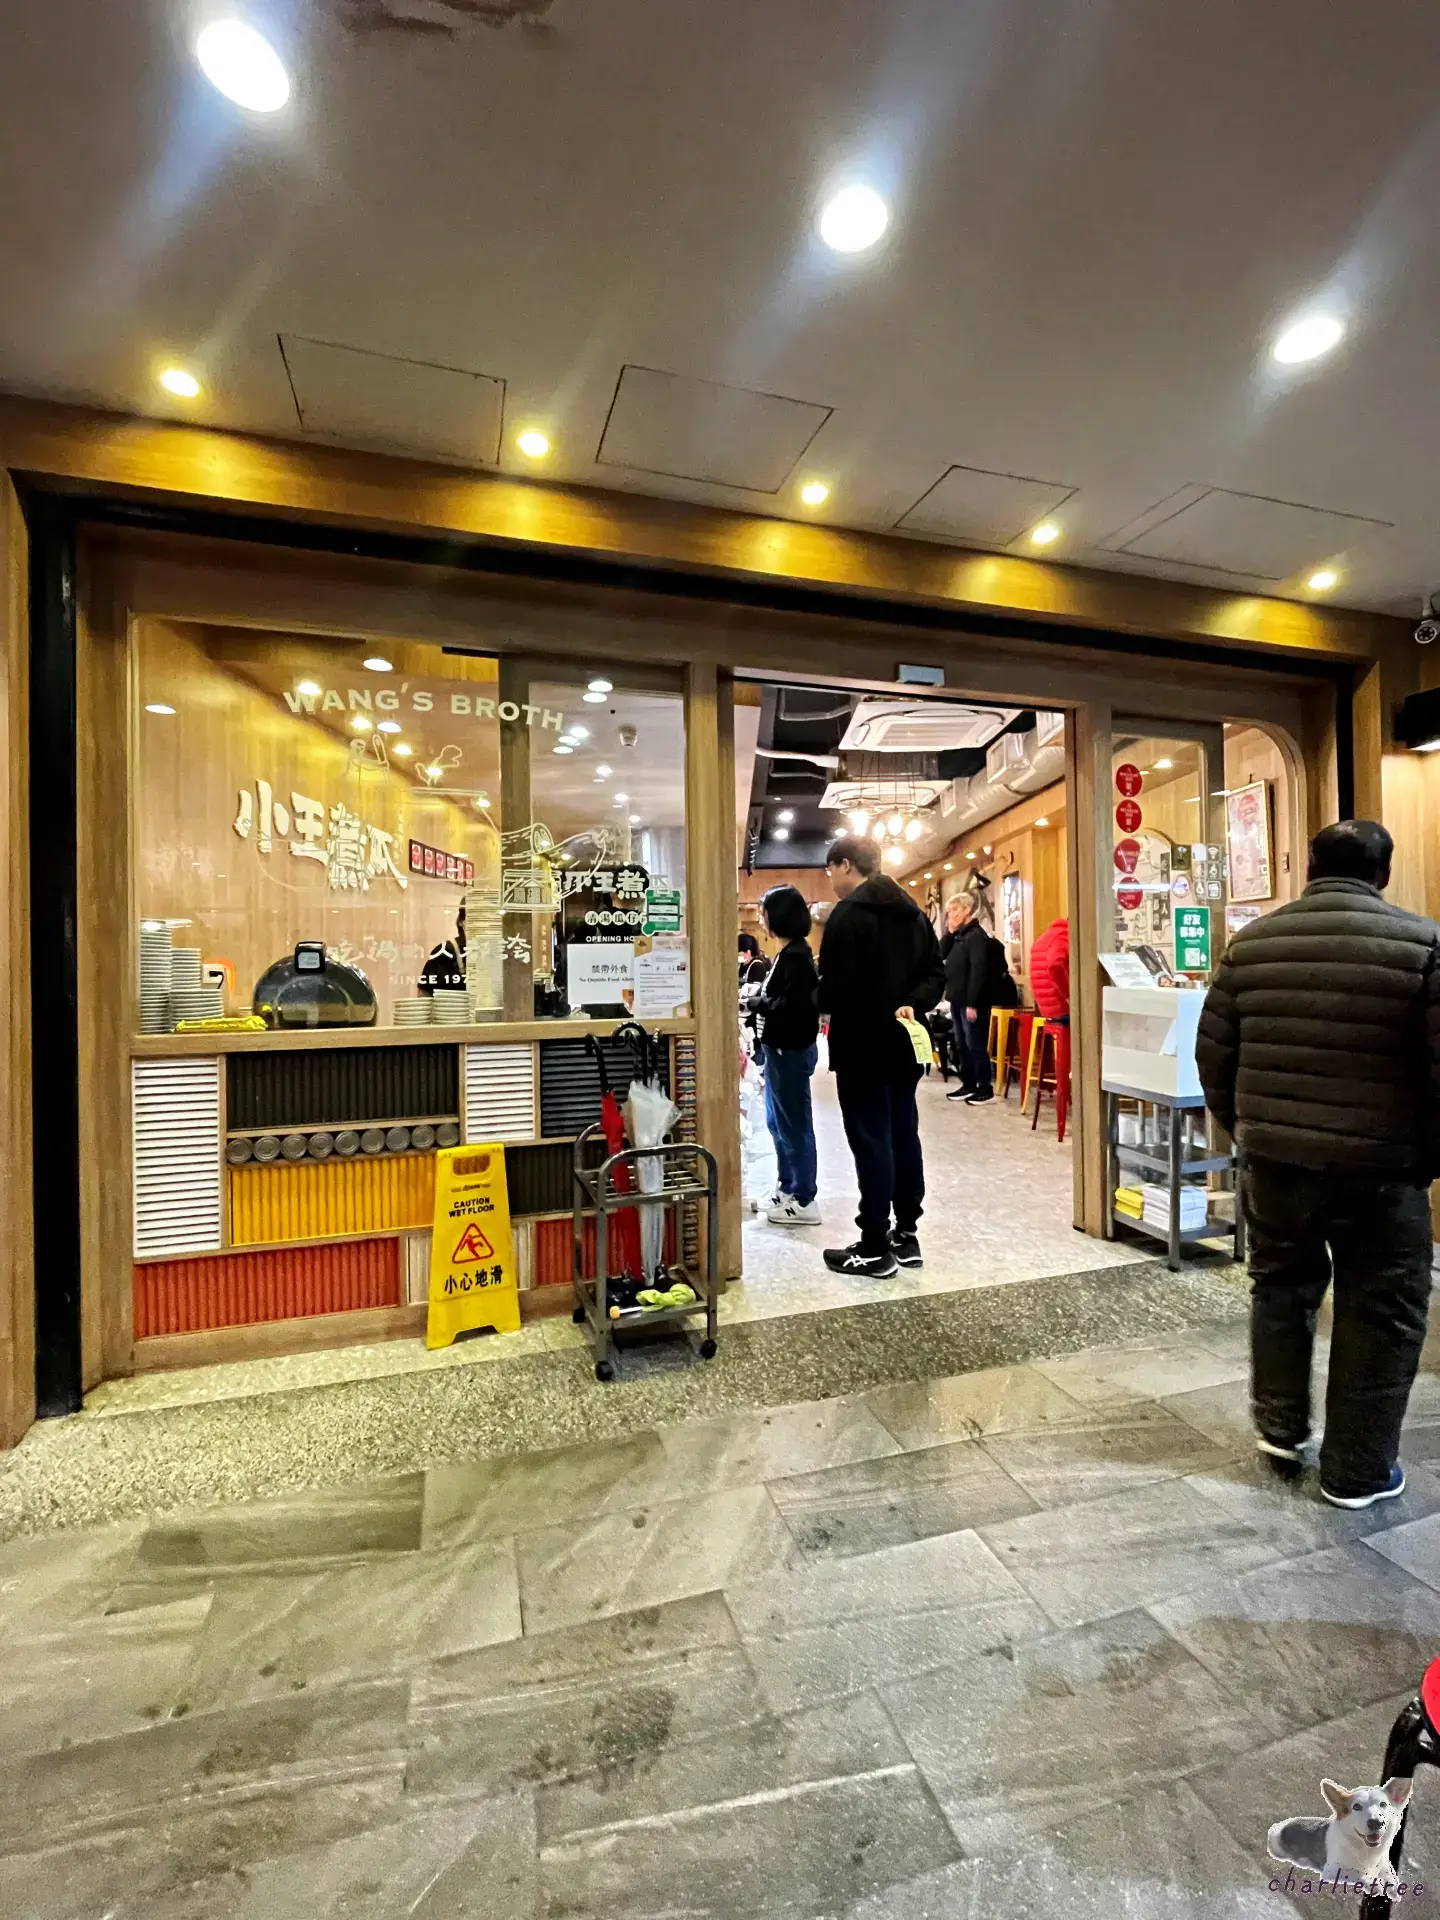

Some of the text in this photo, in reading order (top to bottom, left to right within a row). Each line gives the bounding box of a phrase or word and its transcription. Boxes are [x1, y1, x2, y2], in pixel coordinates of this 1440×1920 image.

[282, 682, 564, 731] WANG'S BROTH
[388, 974, 468, 985] SINCE 197
[454, 1196, 491, 1209] CAUTION
[448, 1204, 495, 1218] WET FLOOR
[785, 1207, 797, 1217] N
[444, 1264, 504, 1295] 小心地滑
